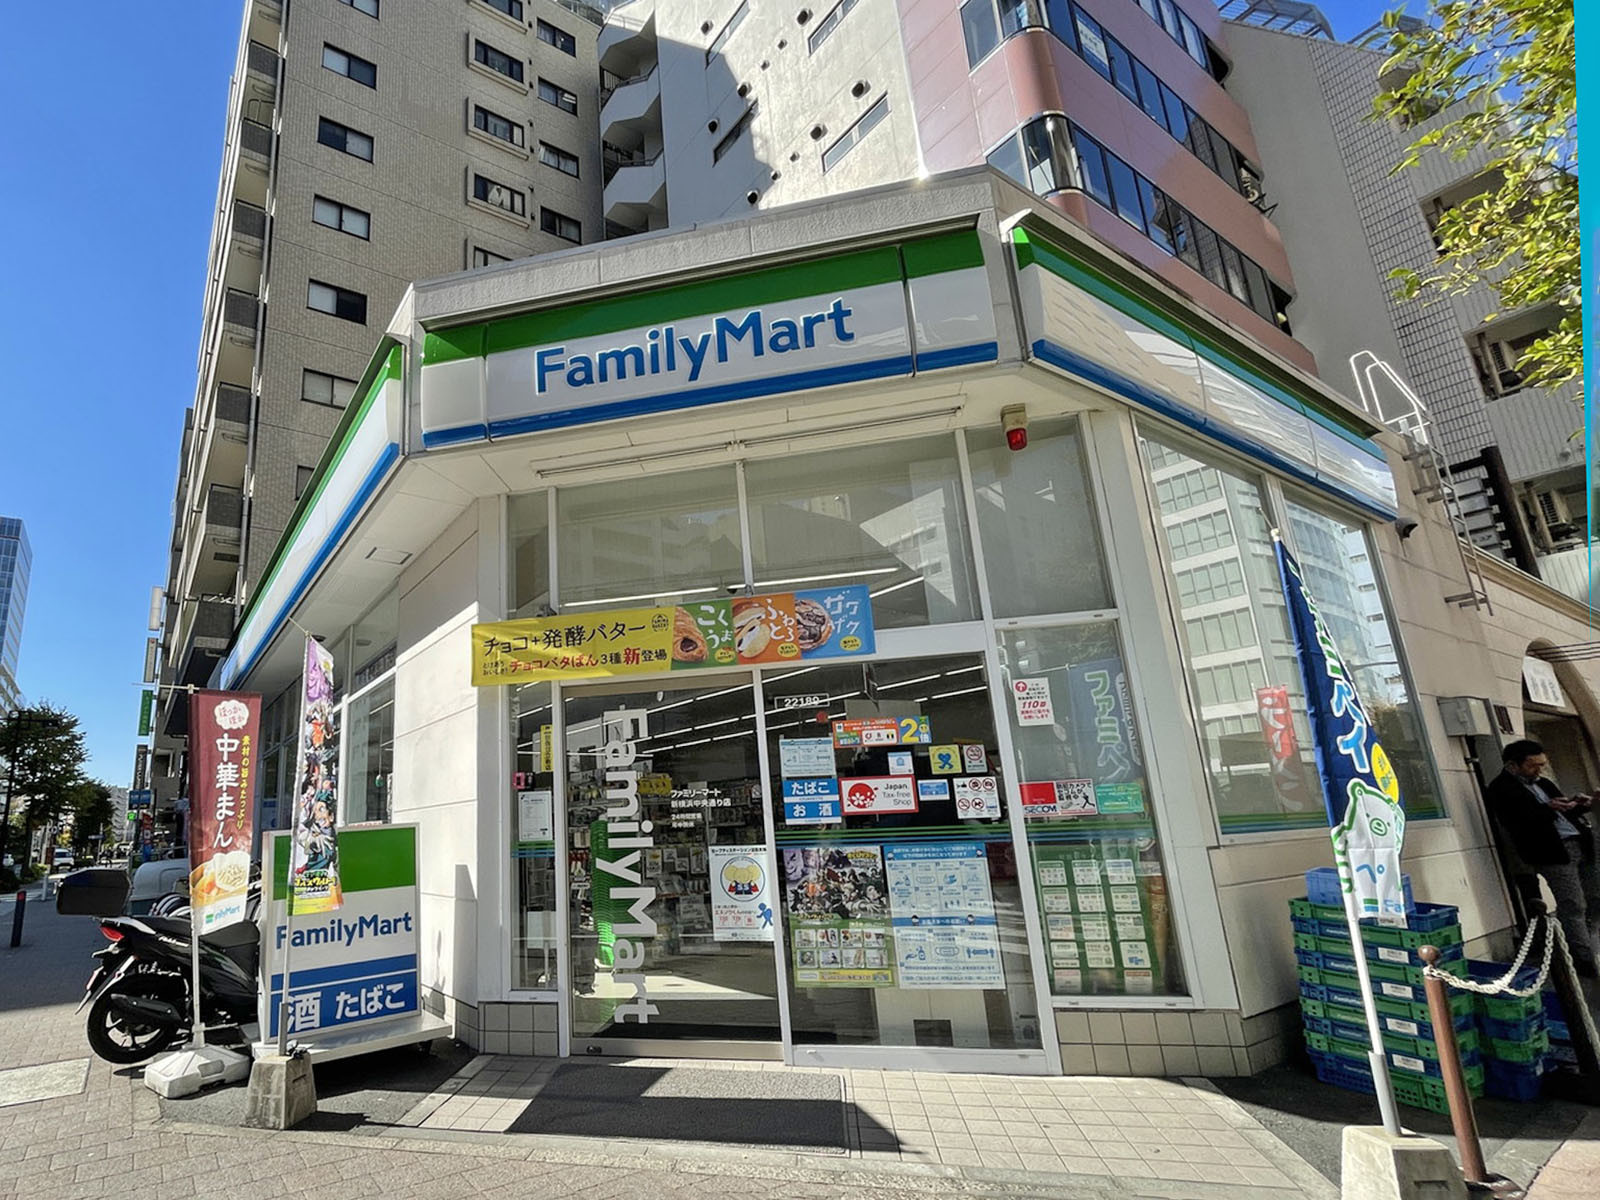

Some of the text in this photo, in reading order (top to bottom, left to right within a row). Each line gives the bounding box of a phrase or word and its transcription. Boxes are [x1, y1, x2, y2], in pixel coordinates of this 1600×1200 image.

[535, 297, 854, 395] FamilyMart
[766, 598, 795, 627] ふわ
[824, 590, 859, 615] ザク
[697, 605, 729, 626] こく
[706, 630, 733, 649] うま
[769, 623, 795, 642] とろ
[213, 733, 240, 849] 中華まん
[671, 788, 722, 799] ファミリーマート
[791, 780, 831, 796] たばこ
[884, 783, 908, 791] Japan
[893, 798, 912, 808] Shop
[1024, 805, 1057, 814] SECOM
[596, 707, 660, 1024] FamilyMart
[276, 912, 412, 949] FamilyMart
[335, 983, 405, 1020] たばこ
